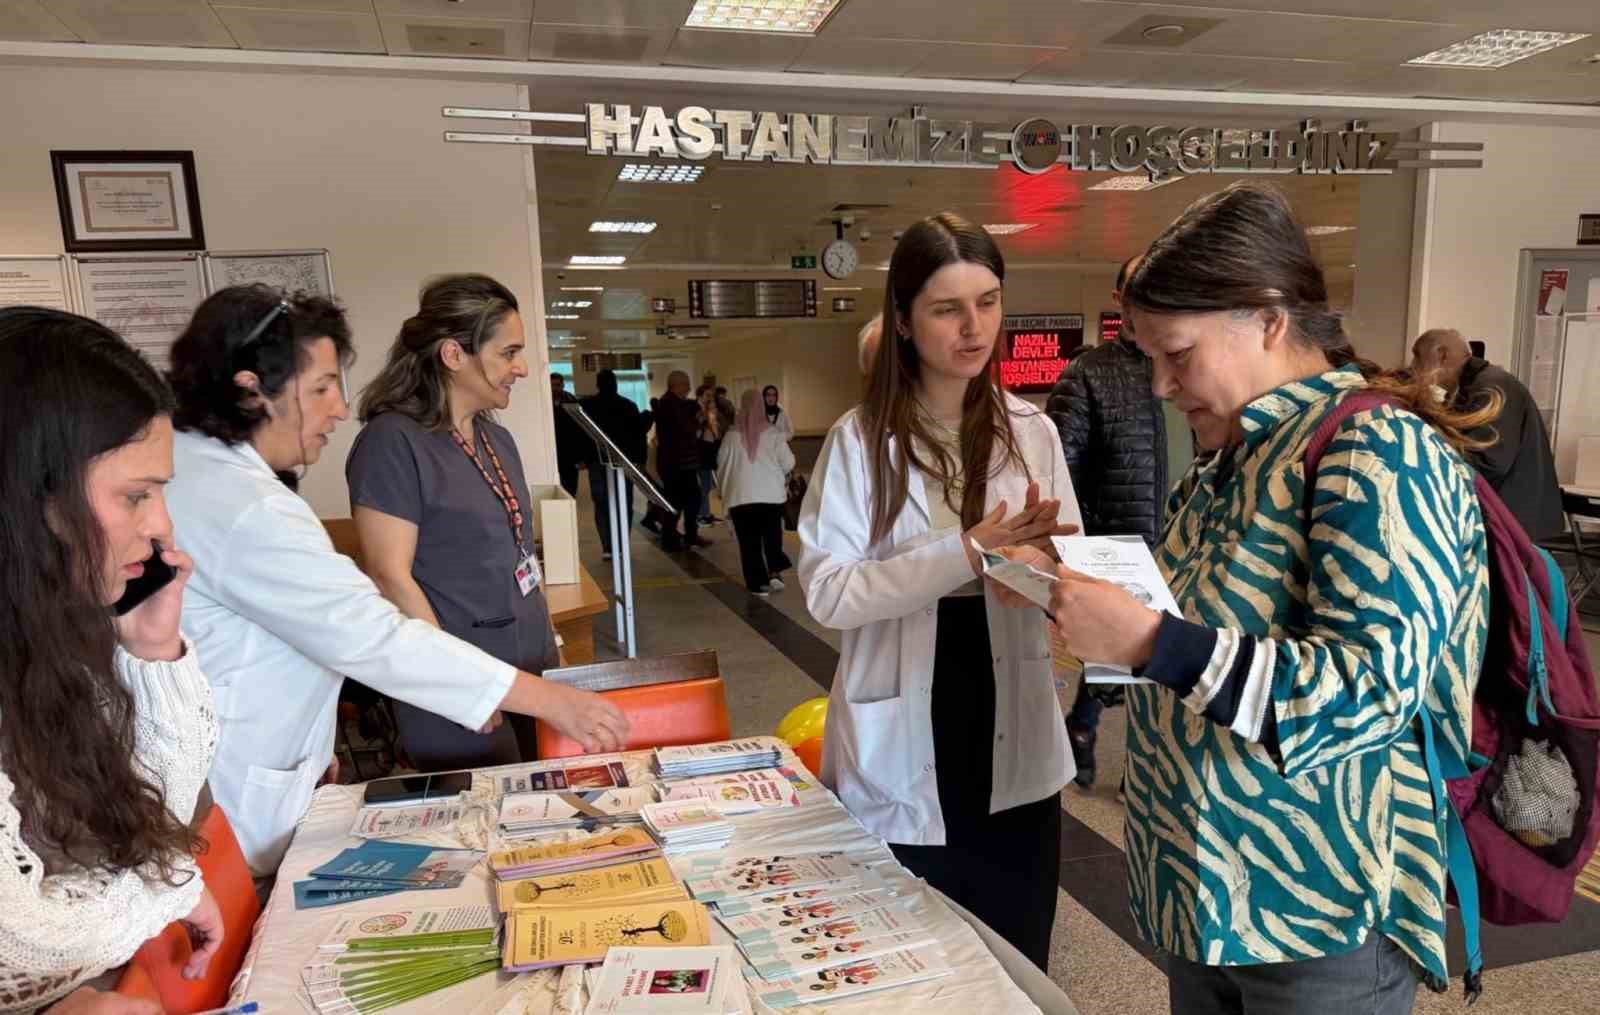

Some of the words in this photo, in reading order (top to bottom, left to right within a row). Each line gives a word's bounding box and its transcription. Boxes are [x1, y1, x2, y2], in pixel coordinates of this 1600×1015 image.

[585, 103, 998, 168] HASTANEMİZE
[1070, 119, 1399, 183] HOŞGELDİNİZ
[1012, 345, 1060, 359] DEVLET
